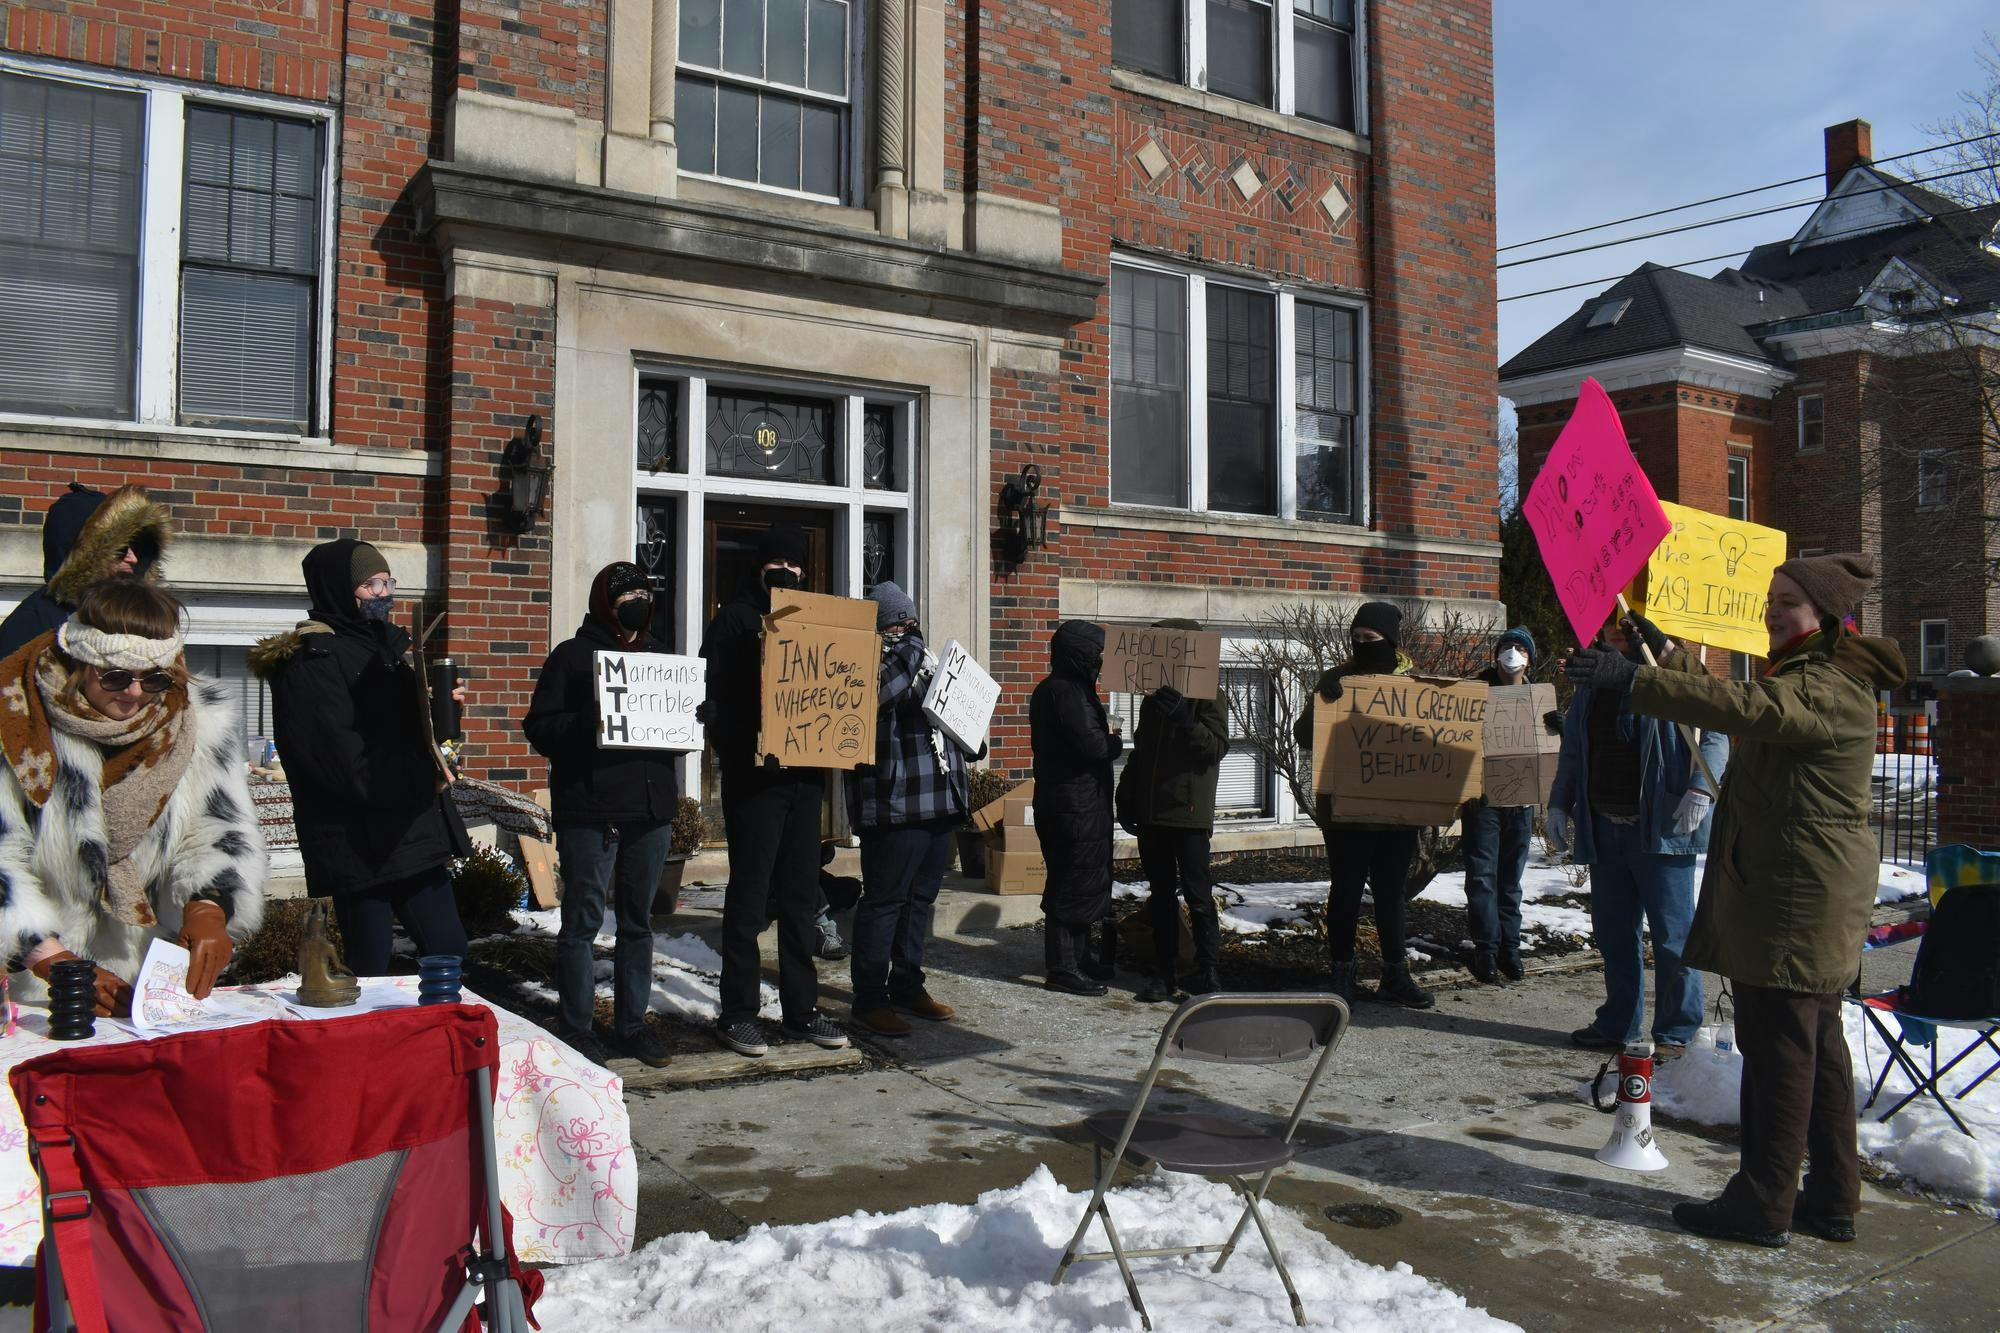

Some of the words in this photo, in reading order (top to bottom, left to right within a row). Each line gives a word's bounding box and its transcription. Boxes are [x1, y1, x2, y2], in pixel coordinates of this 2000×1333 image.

[758, 429, 776, 447] 108
[1114, 631, 1197, 660] ABOLISH
[604, 656, 698, 685] Maintains
[777, 639, 819, 684] IAN
[1124, 659, 1208, 694] RENT
[606, 686, 694, 714] Terrible
[1343, 686, 1408, 718] IAN
[1416, 687, 1487, 722] GREENLEE
[607, 714, 695, 743] Homes!
[784, 713, 832, 757] AT?
[1352, 723, 1425, 750] WIPE
[1429, 724, 1474, 748] YOUR
[1360, 751, 1451, 784] BEHIND!
